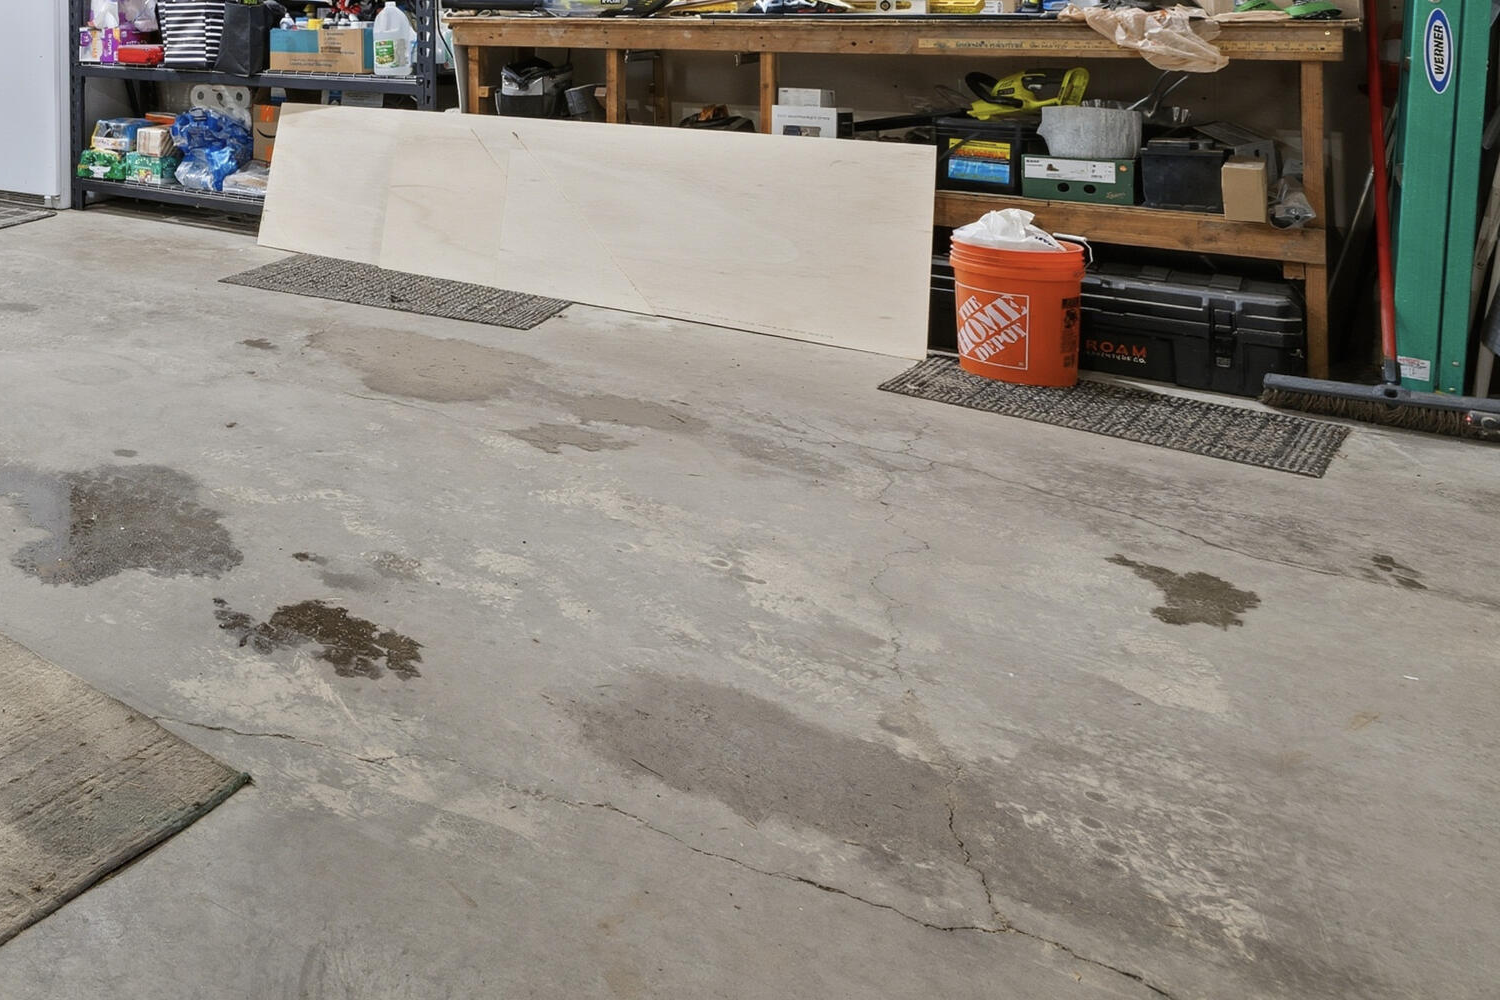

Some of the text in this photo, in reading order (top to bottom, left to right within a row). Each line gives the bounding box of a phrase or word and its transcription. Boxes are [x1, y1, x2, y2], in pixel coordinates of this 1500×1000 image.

[1433, 25, 1444, 75] WERNER
[957, 294, 1027, 355] HOME
[959, 295, 982, 320] THE
[974, 322, 1026, 361] DEPOT
[1085, 339, 1147, 357] ROAM
